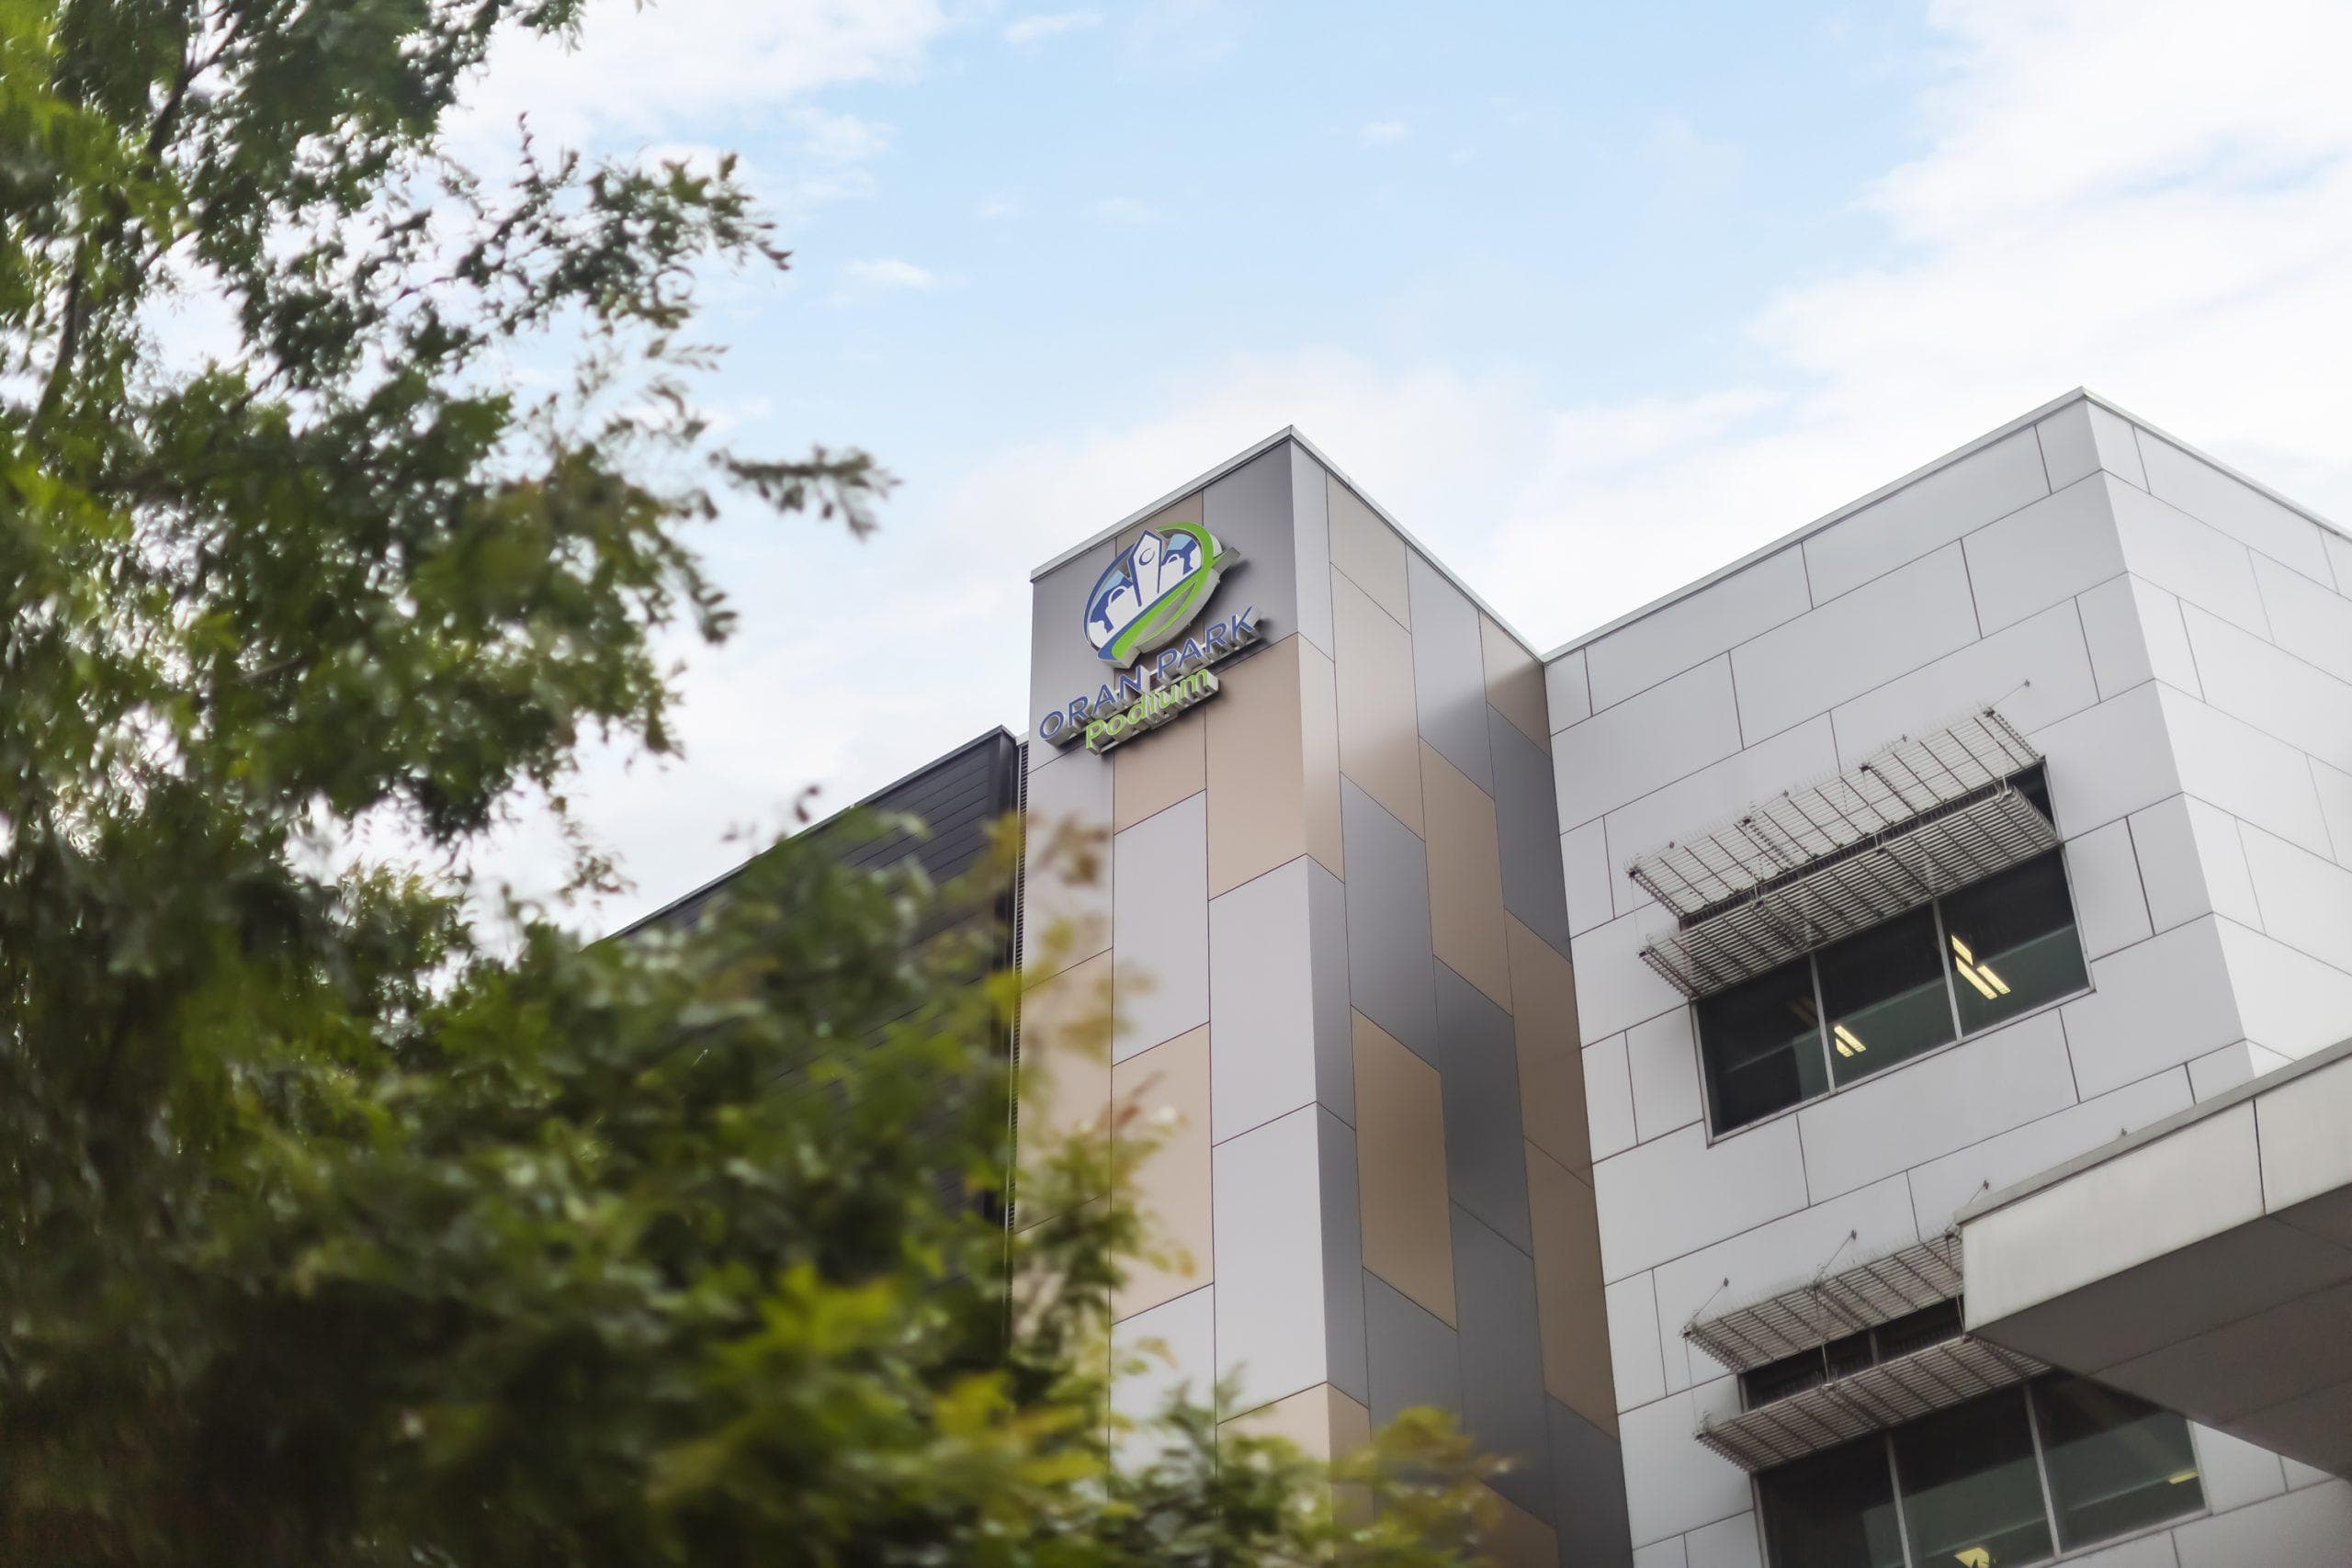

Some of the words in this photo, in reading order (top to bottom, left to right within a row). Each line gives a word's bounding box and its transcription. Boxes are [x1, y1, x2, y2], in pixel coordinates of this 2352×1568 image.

[1039, 665, 1144, 739] ORAN
[1157, 605, 1255, 679] PARK
[1085, 668, 1210, 750] Podium
